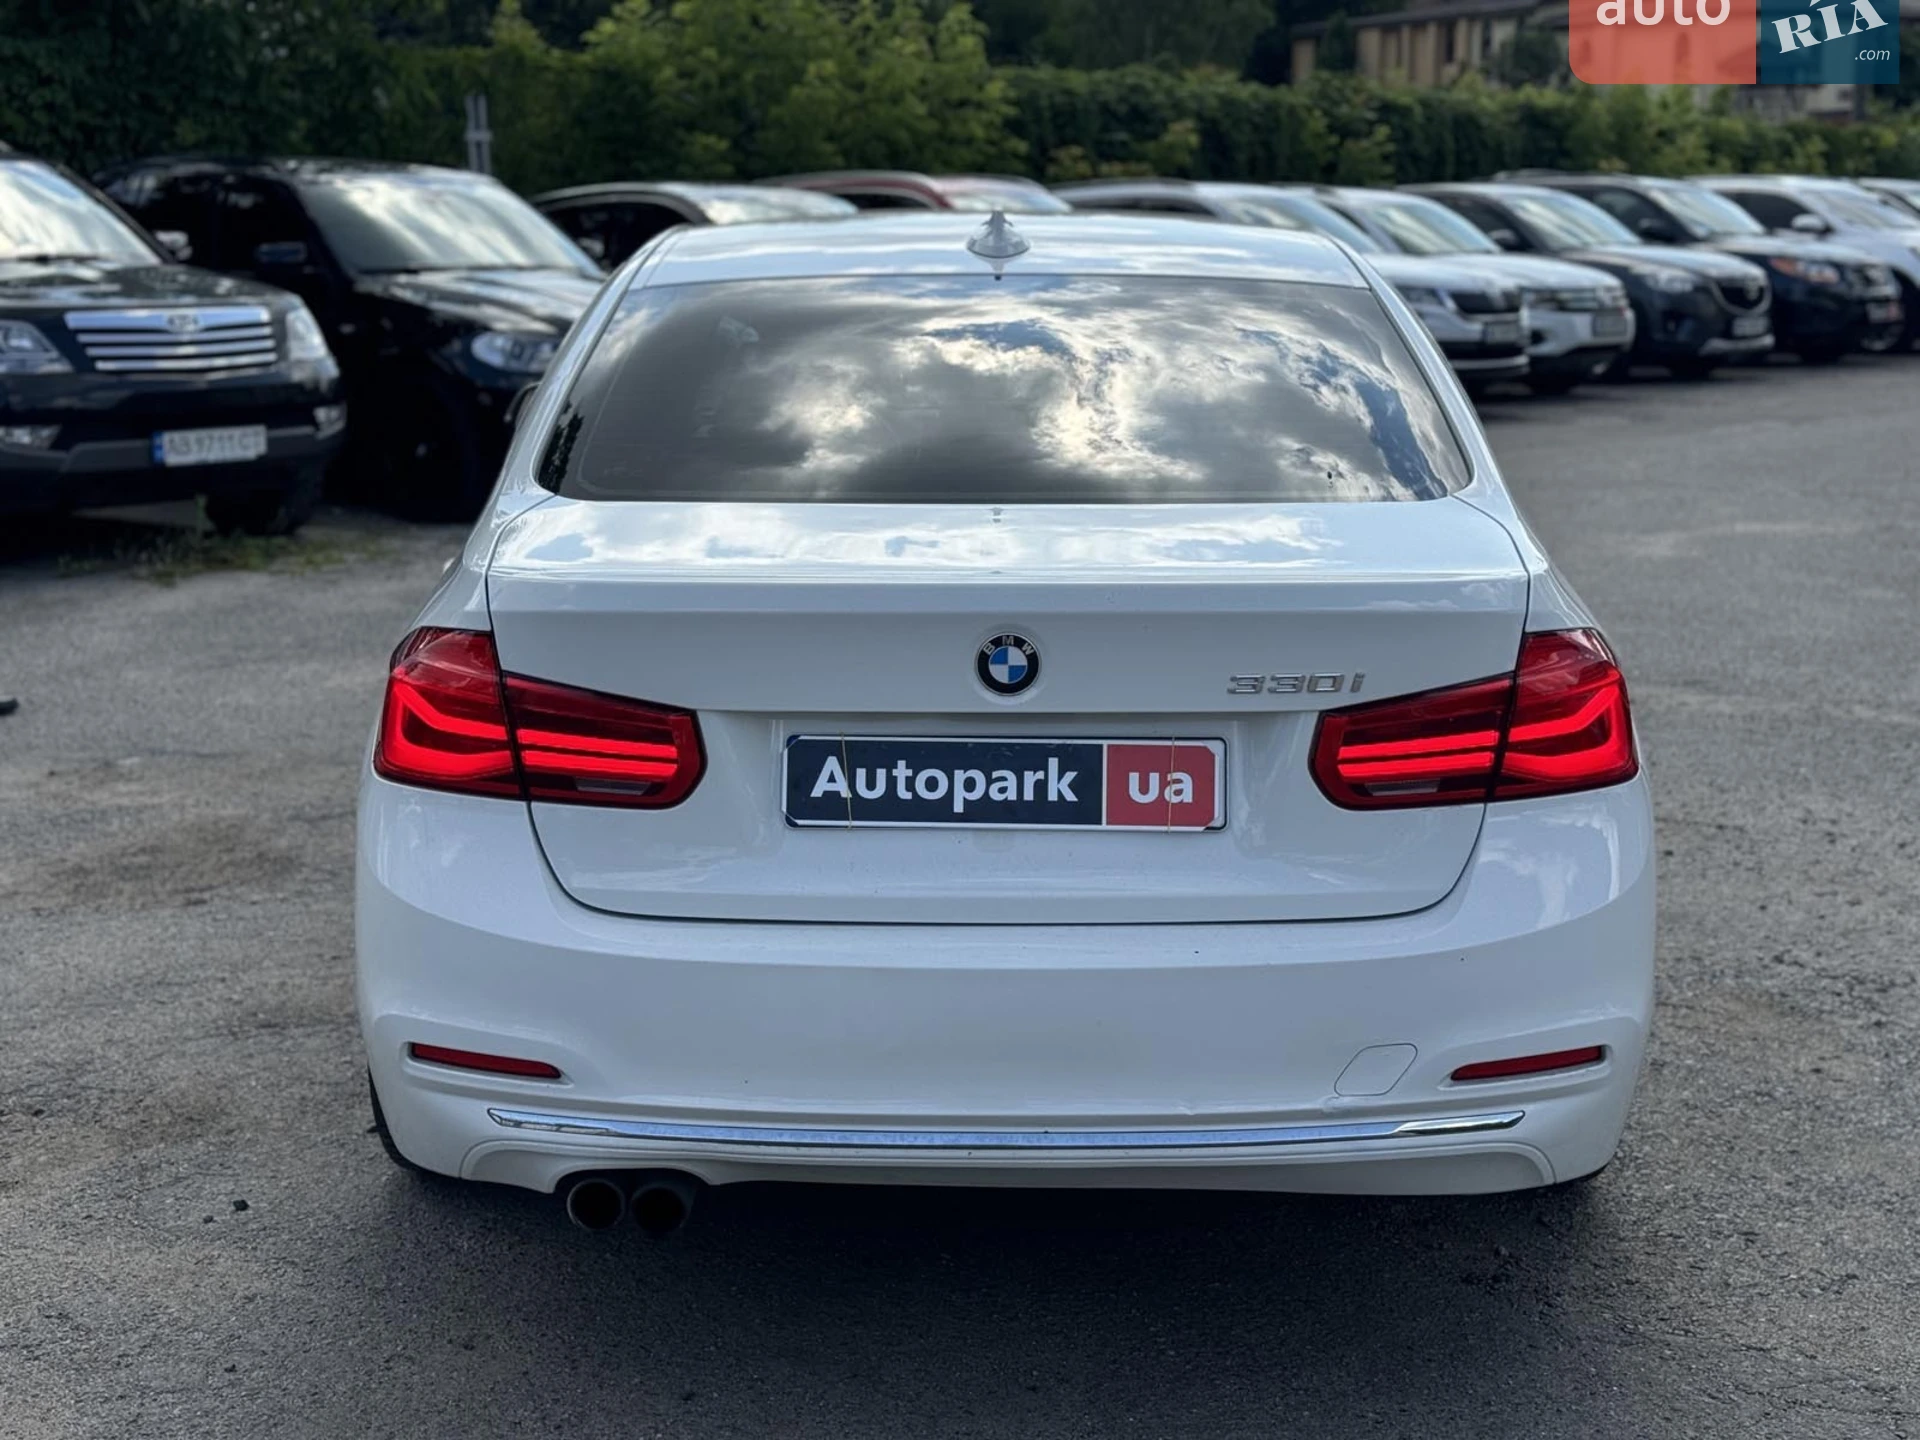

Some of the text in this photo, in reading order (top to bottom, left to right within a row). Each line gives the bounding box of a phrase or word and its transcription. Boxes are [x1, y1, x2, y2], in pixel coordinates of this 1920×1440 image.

[983, 635, 1034, 655] BMW
[1227, 672, 1365, 694] 330i
[810, 756, 1194, 813] Autopark ua
